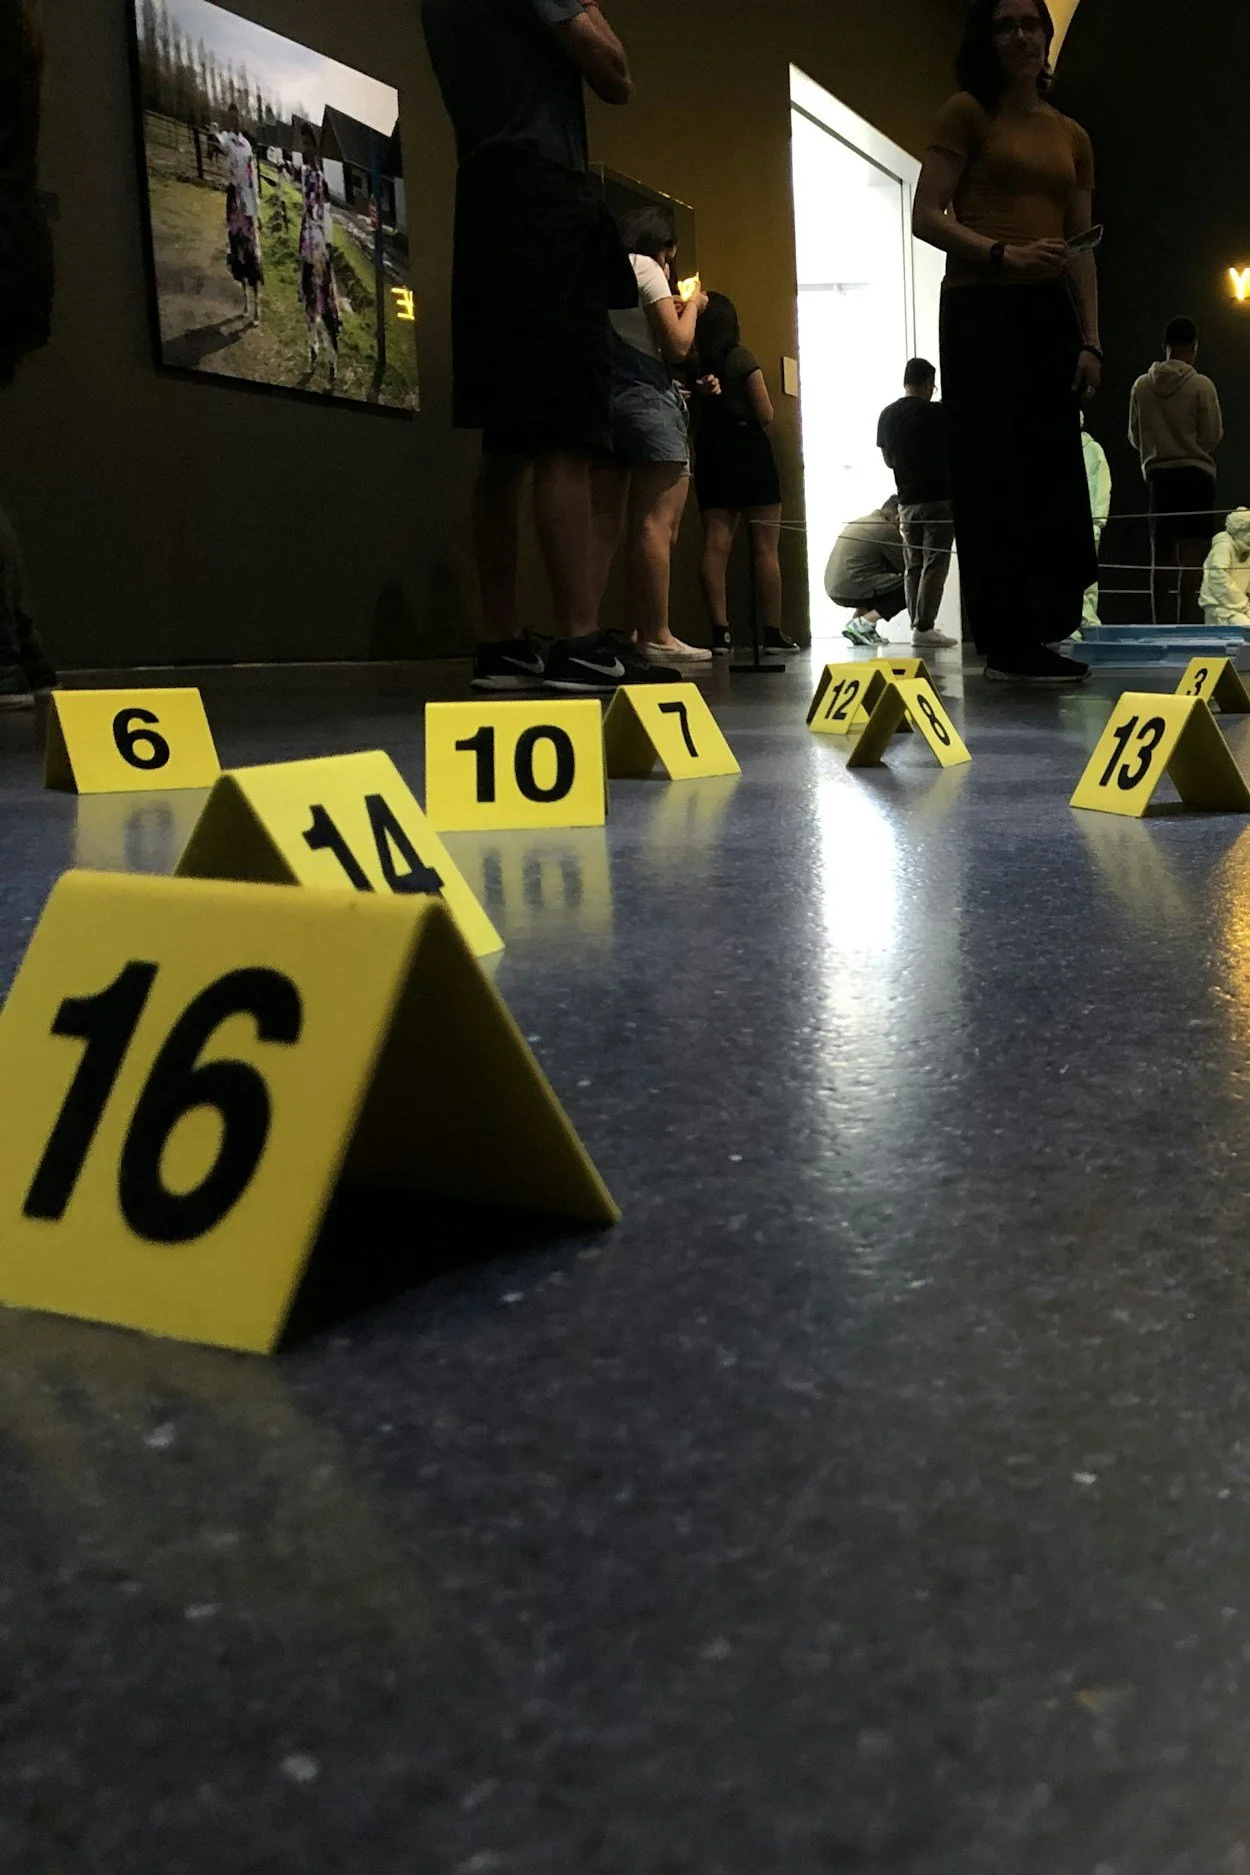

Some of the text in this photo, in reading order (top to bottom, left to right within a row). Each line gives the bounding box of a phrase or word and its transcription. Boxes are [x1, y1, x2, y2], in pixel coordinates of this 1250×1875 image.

[825, 679, 859, 720] 12
[1185, 667, 1208, 696] 3
[113, 708, 170, 770] 6
[658, 702, 699, 757] 7
[917, 695, 951, 746] 8
[456, 725, 575, 802] 10
[1099, 715, 1166, 791] 13
[302, 794, 445, 893] 14
[22, 960, 303, 1245] 16
